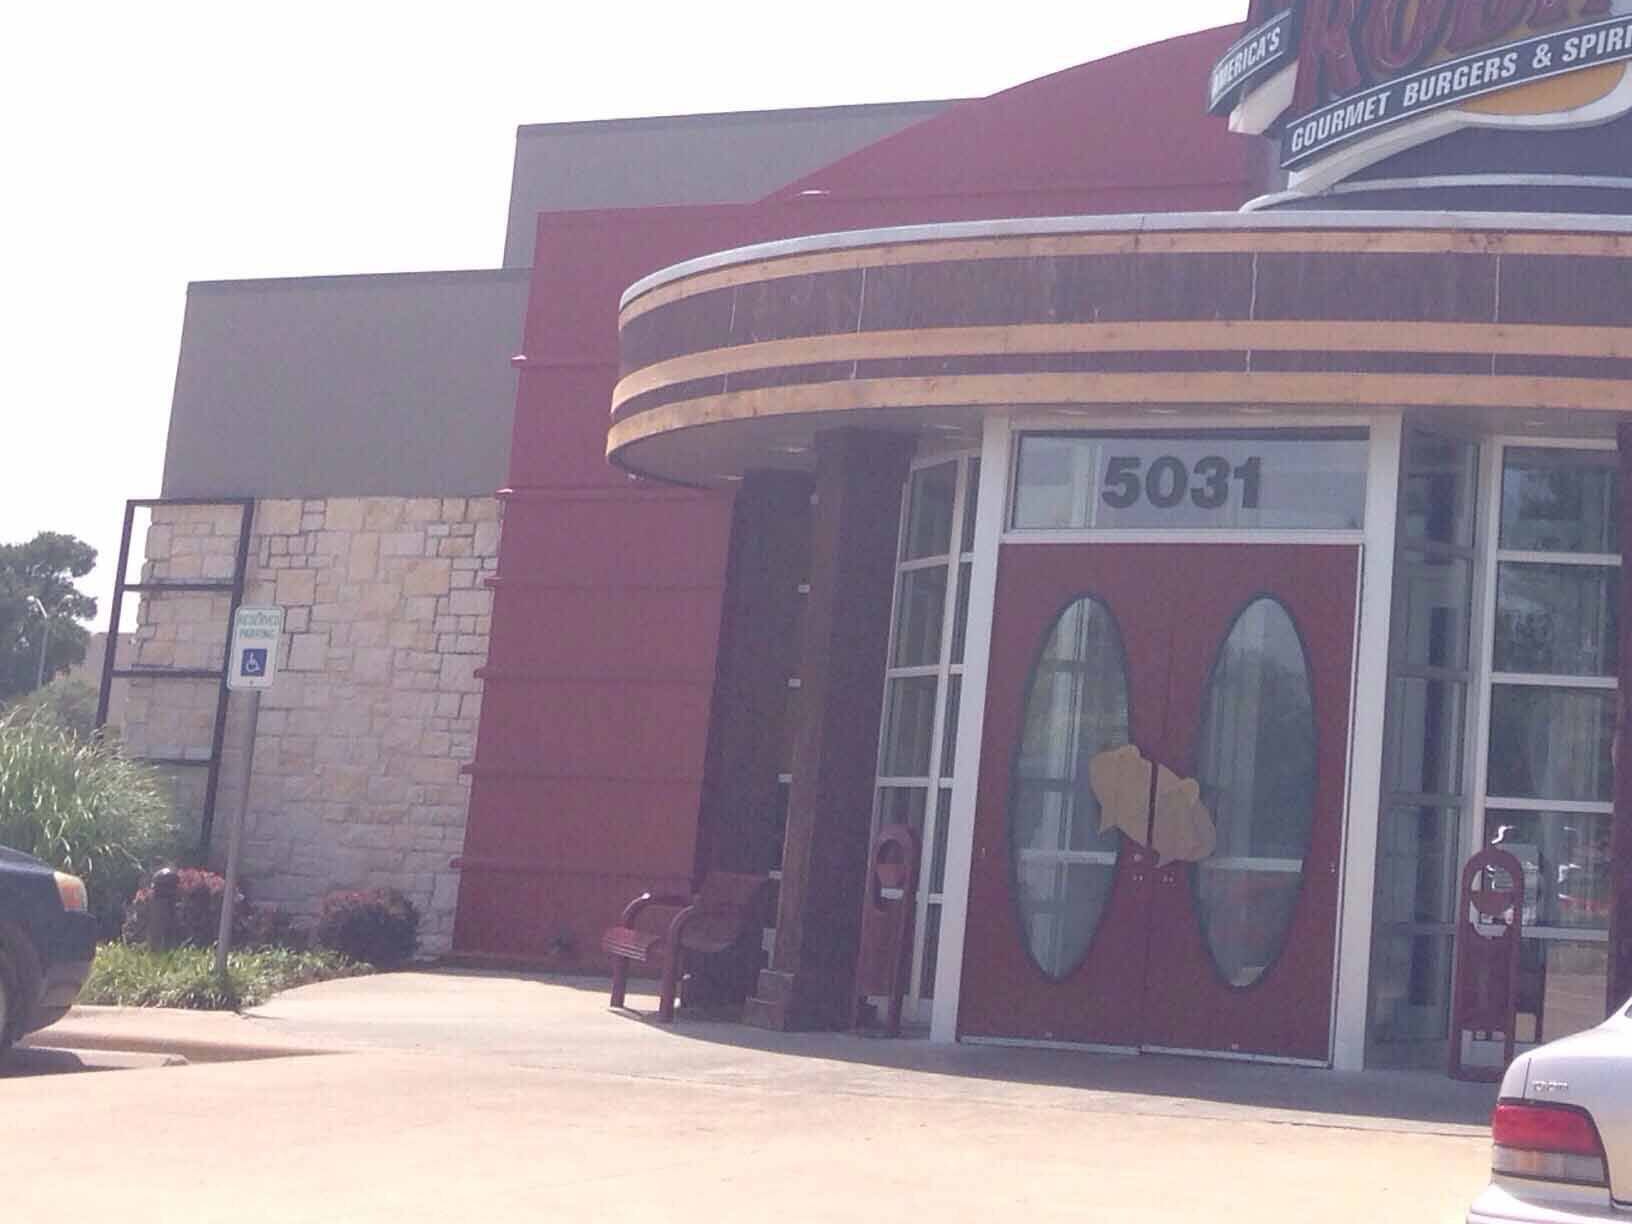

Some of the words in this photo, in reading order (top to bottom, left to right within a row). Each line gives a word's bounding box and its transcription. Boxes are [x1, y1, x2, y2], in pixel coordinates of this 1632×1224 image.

[1291, 91, 1392, 152] GOURMET
[1403, 53, 1518, 107] BURGERS
[1532, 43, 1552, 70] &
[1102, 455, 1262, 509] 5031
